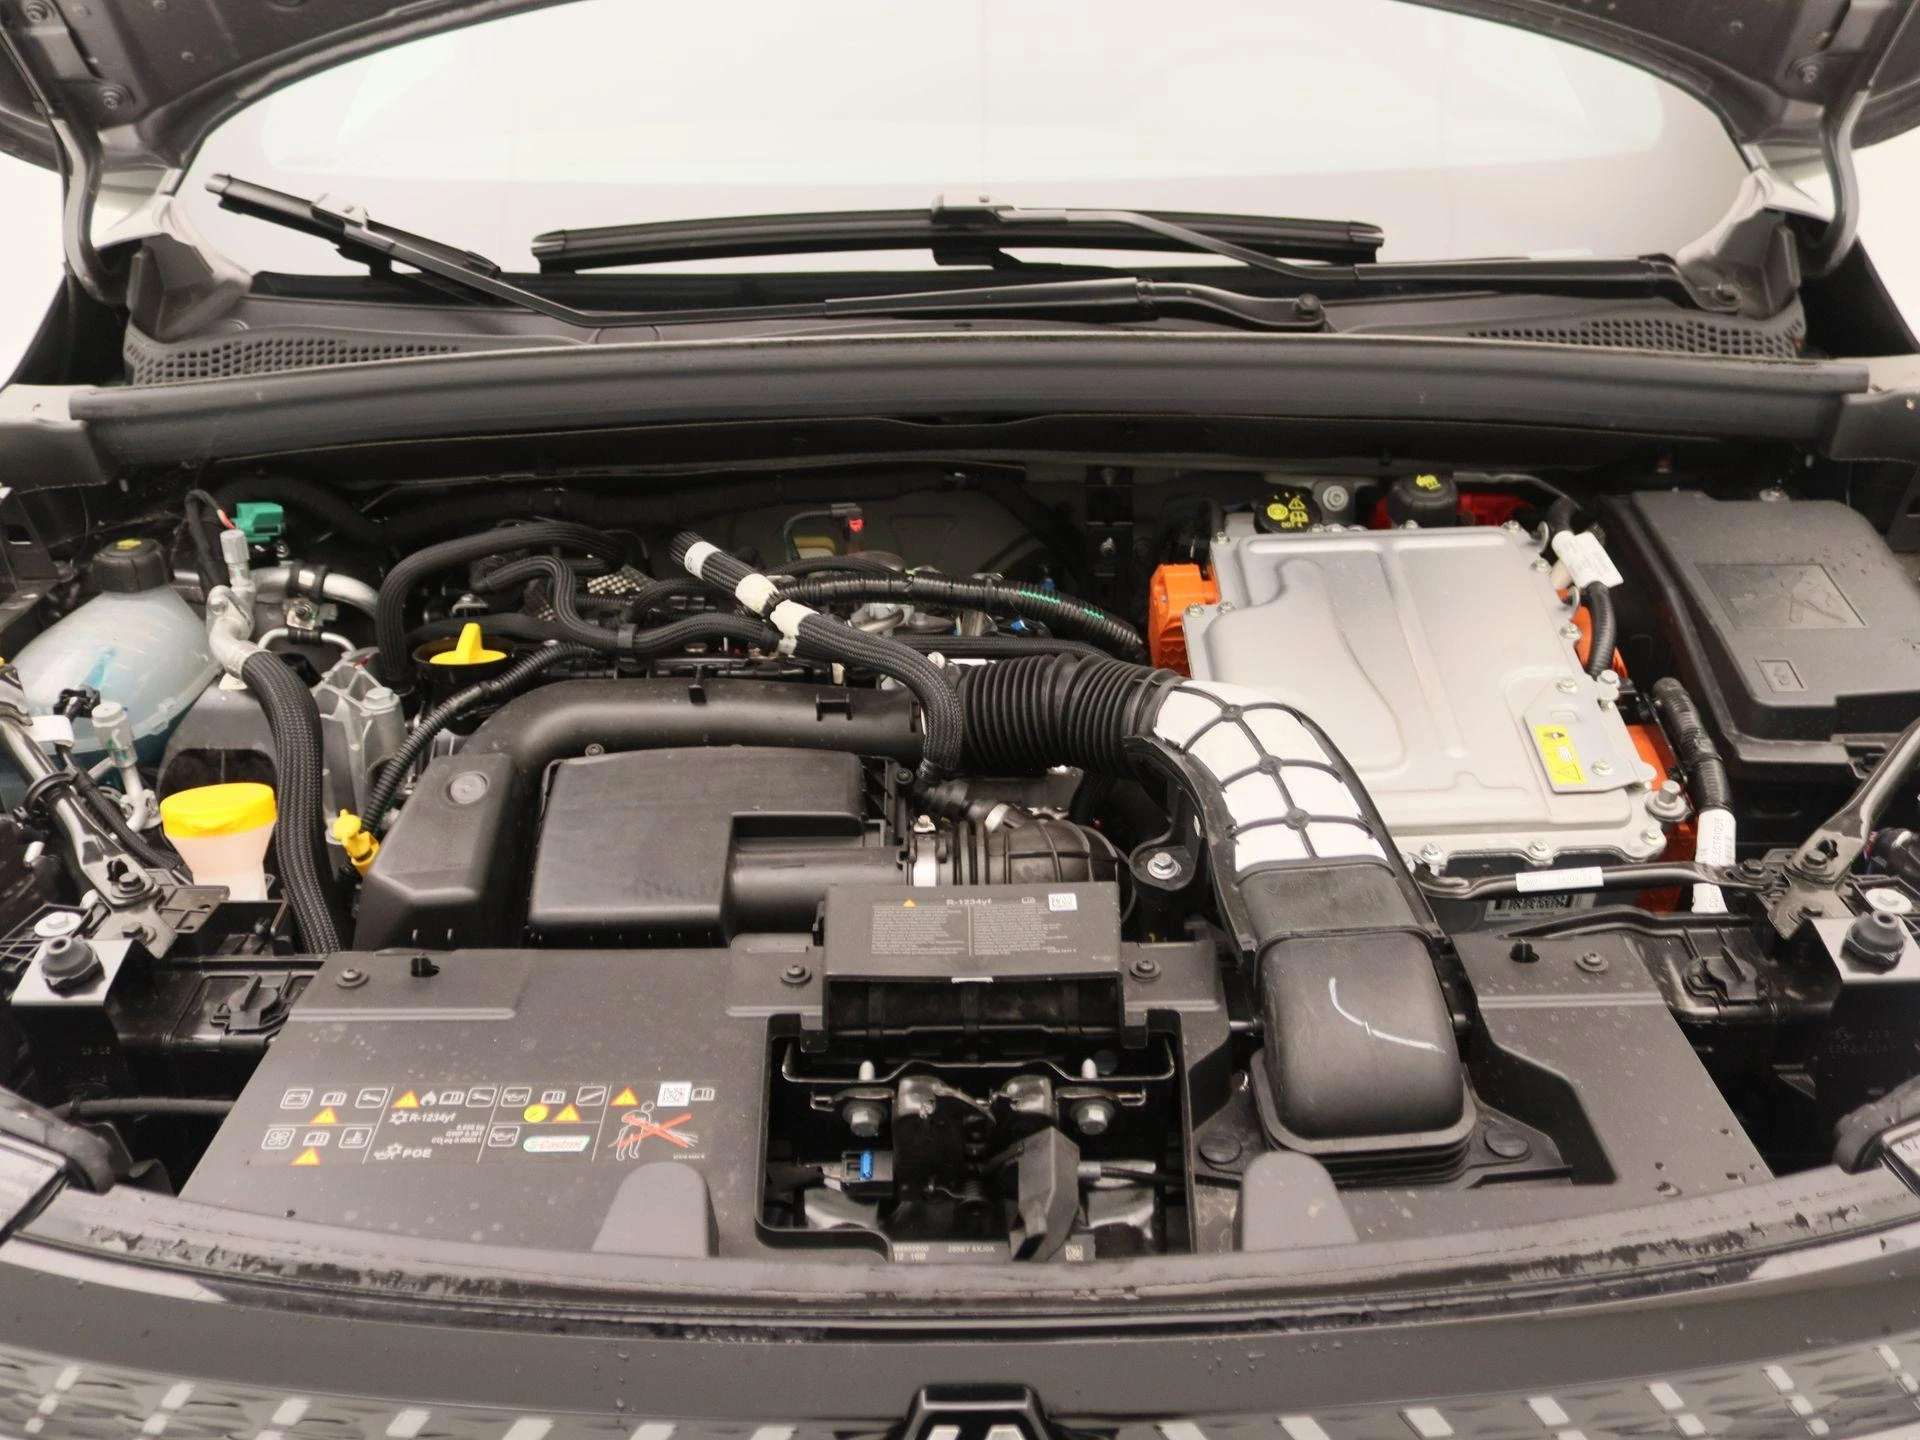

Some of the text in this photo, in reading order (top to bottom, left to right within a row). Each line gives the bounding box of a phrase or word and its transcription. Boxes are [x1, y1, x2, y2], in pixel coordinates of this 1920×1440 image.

[946, 898, 992, 907] R-1234yf
[409, 1112, 456, 1124] R-1234yf
[538, 1139, 584, 1150] Castrol
[402, 1148, 432, 1158] POE
